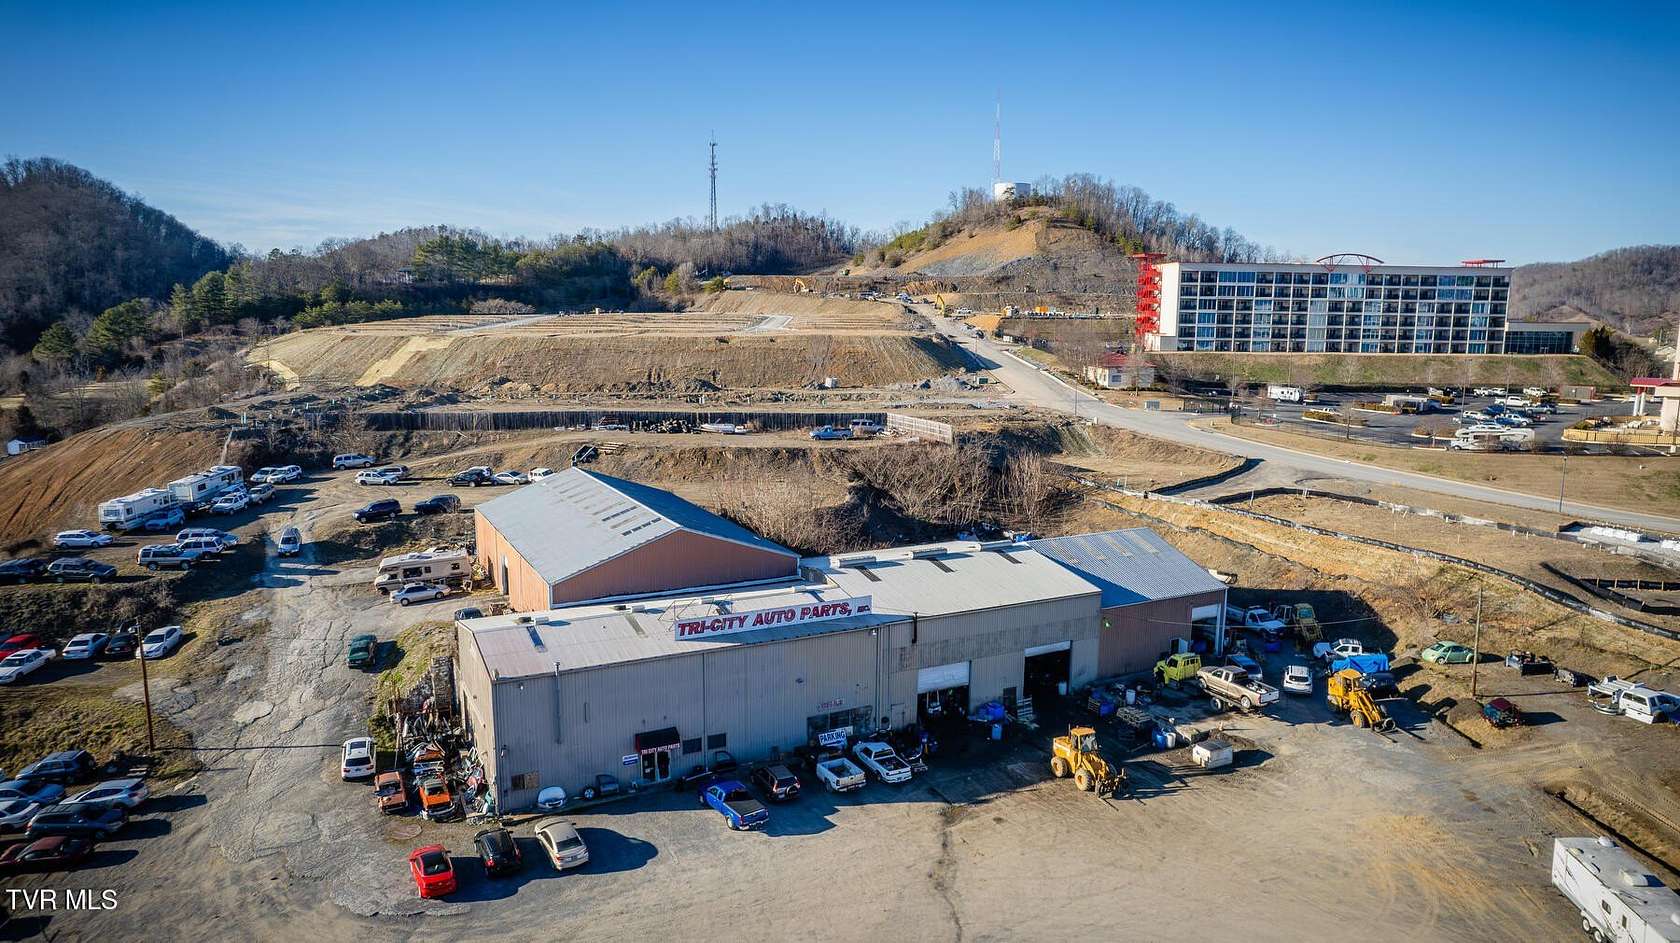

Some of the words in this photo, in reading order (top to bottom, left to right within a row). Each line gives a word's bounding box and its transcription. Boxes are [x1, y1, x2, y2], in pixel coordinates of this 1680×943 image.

[678, 616, 748, 636] TRI-CITY
[752, 608, 796, 627] AUTO
[800, 602, 852, 620] PARTS,
[820, 730, 846, 744] PARKING
